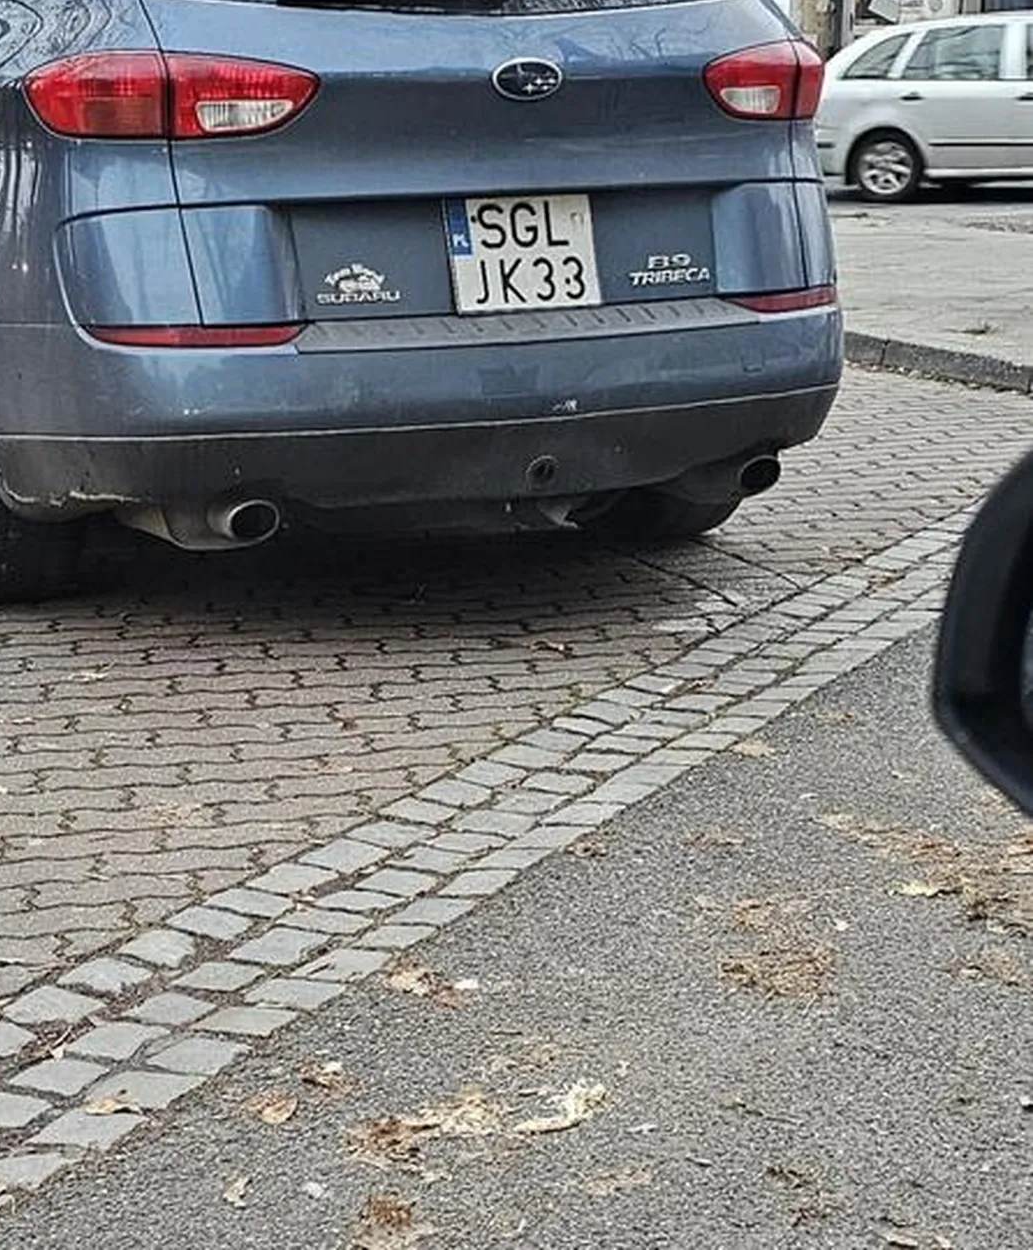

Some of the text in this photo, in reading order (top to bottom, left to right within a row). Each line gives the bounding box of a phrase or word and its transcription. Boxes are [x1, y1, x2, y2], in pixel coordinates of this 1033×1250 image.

[477, 201, 570, 249] SGL
[647, 253, 692, 269] B9
[476, 256, 586, 305] JK33
[629, 267, 711, 286] TRIBECA
[317, 290, 400, 304] SUBARU
